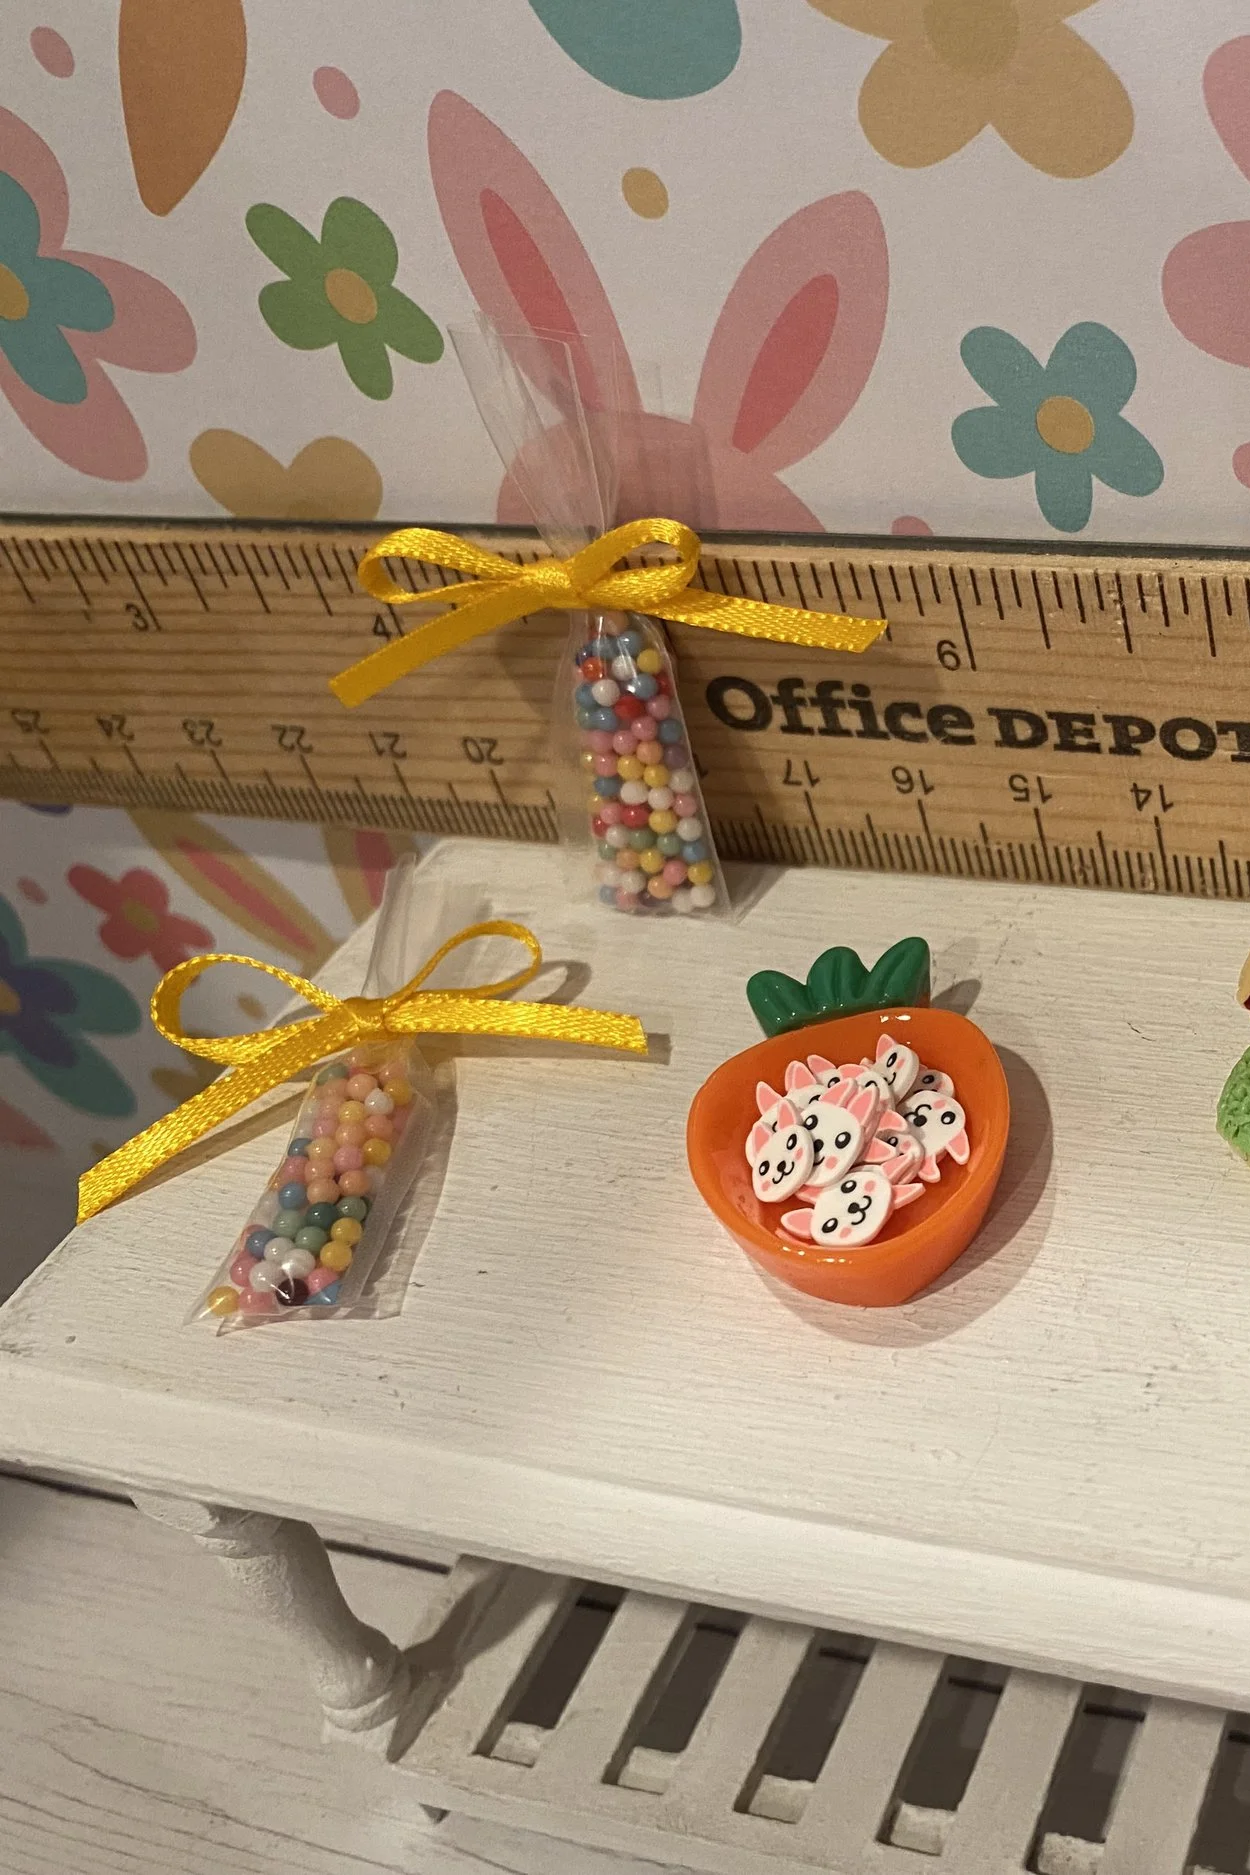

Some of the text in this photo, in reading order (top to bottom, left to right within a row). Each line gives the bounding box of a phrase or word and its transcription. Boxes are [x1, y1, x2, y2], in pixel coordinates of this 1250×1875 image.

[125, 603, 149, 631] 3
[373, 613, 391, 641] 4
[936, 640, 960, 671] 6
[706, 675, 976, 746] Office
[182, 719, 222, 746] 23
[271, 724, 313, 753] 22
[369, 732, 407, 759] 21
[462, 736, 504, 766] 20
[783, 759, 820, 787] 17
[891, 766, 934, 795] 16
[1009, 775, 1052, 804] 15
[1130, 782, 1174, 813] 14
